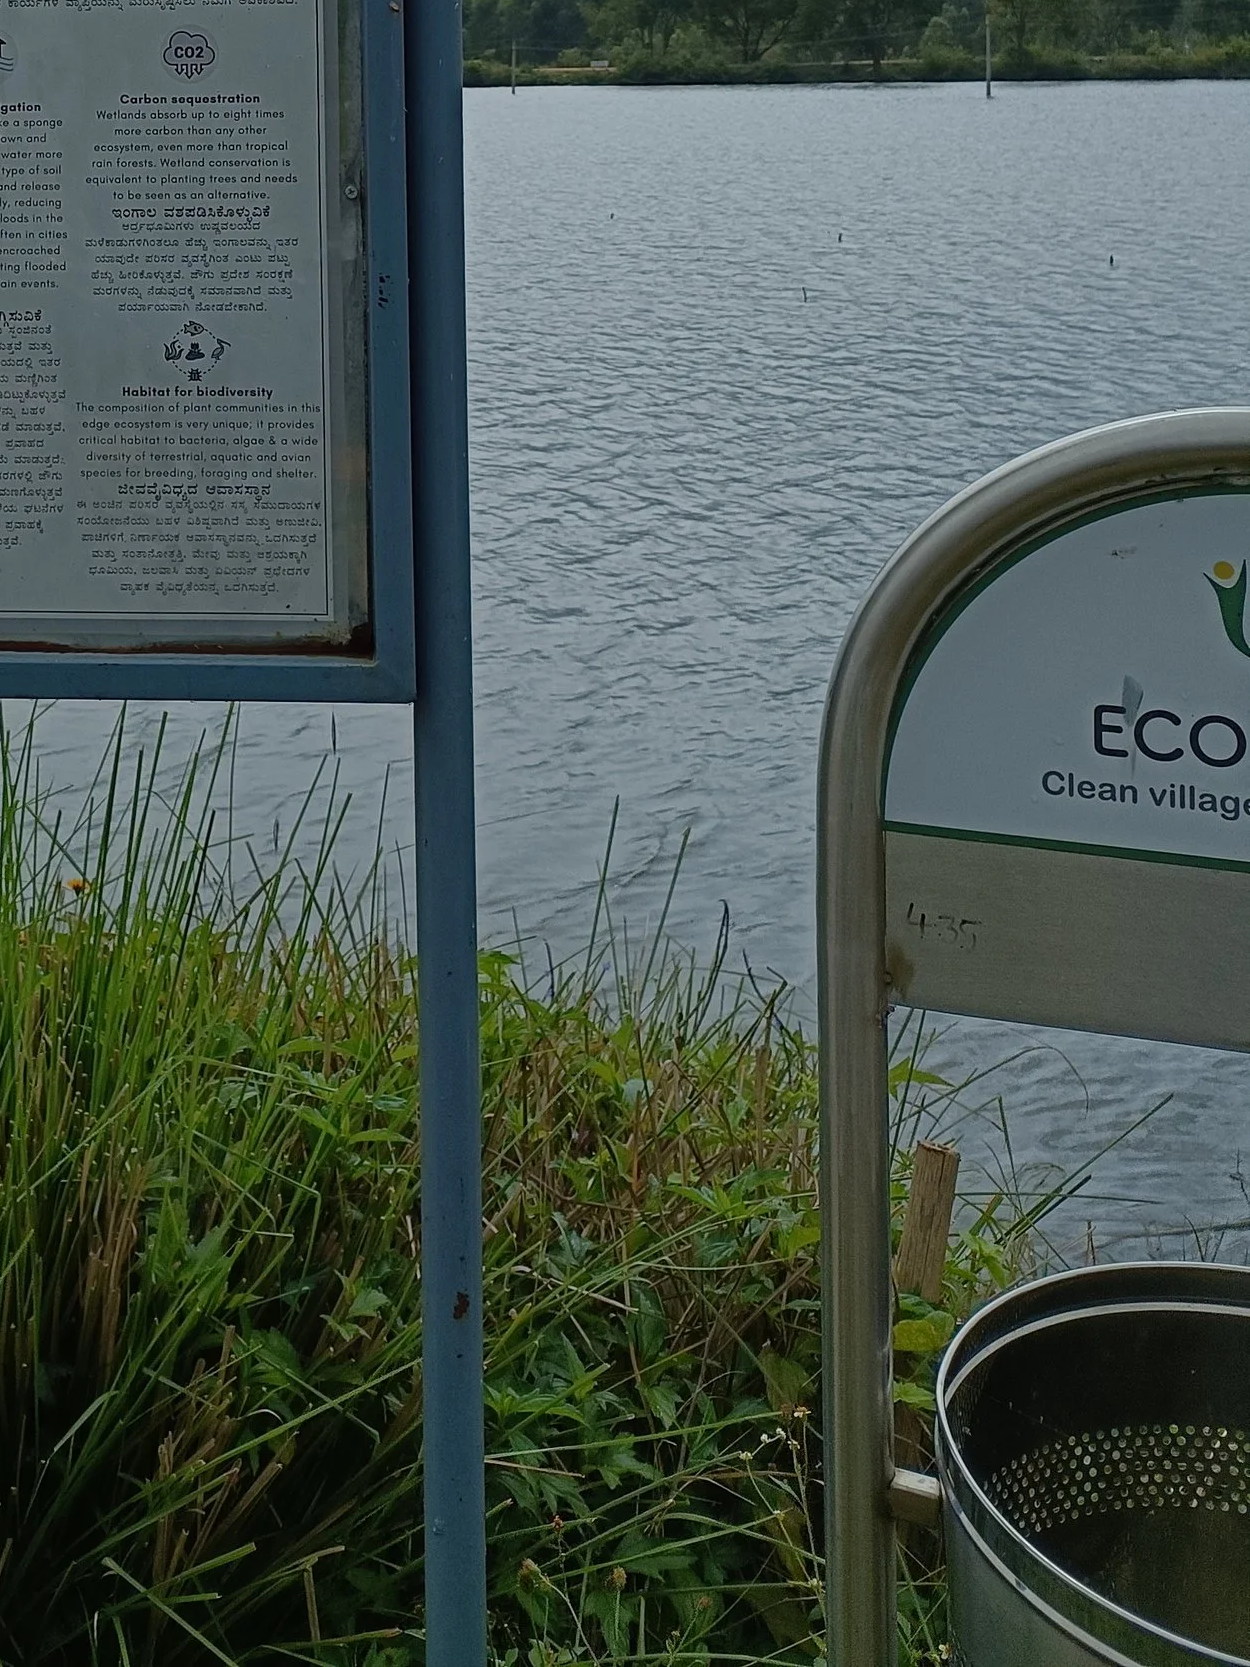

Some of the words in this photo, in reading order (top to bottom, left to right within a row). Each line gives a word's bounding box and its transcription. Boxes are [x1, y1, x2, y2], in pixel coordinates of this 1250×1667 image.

[174, 46, 205, 59] CO2
[120, 94, 167, 104] Carbon
[172, 94, 259, 106] sequestration
[94, 143, 153, 154] ecosystem,
[218, 141, 241, 150] than
[246, 141, 287, 153] tropical
[1, 151, 31, 159] water
[123, 386, 170, 396] Habitat
[175, 386, 192, 396] for
[197, 386, 273, 399] biodiversity
[87, 450, 131, 463] diversity
[150, 451, 206, 462] terrestrial,
[211, 453, 252, 463] aquatic
[257, 451, 277, 462] and
[1094, 705, 1247, 768] ECO
[1042, 770, 1138, 804] Clean
